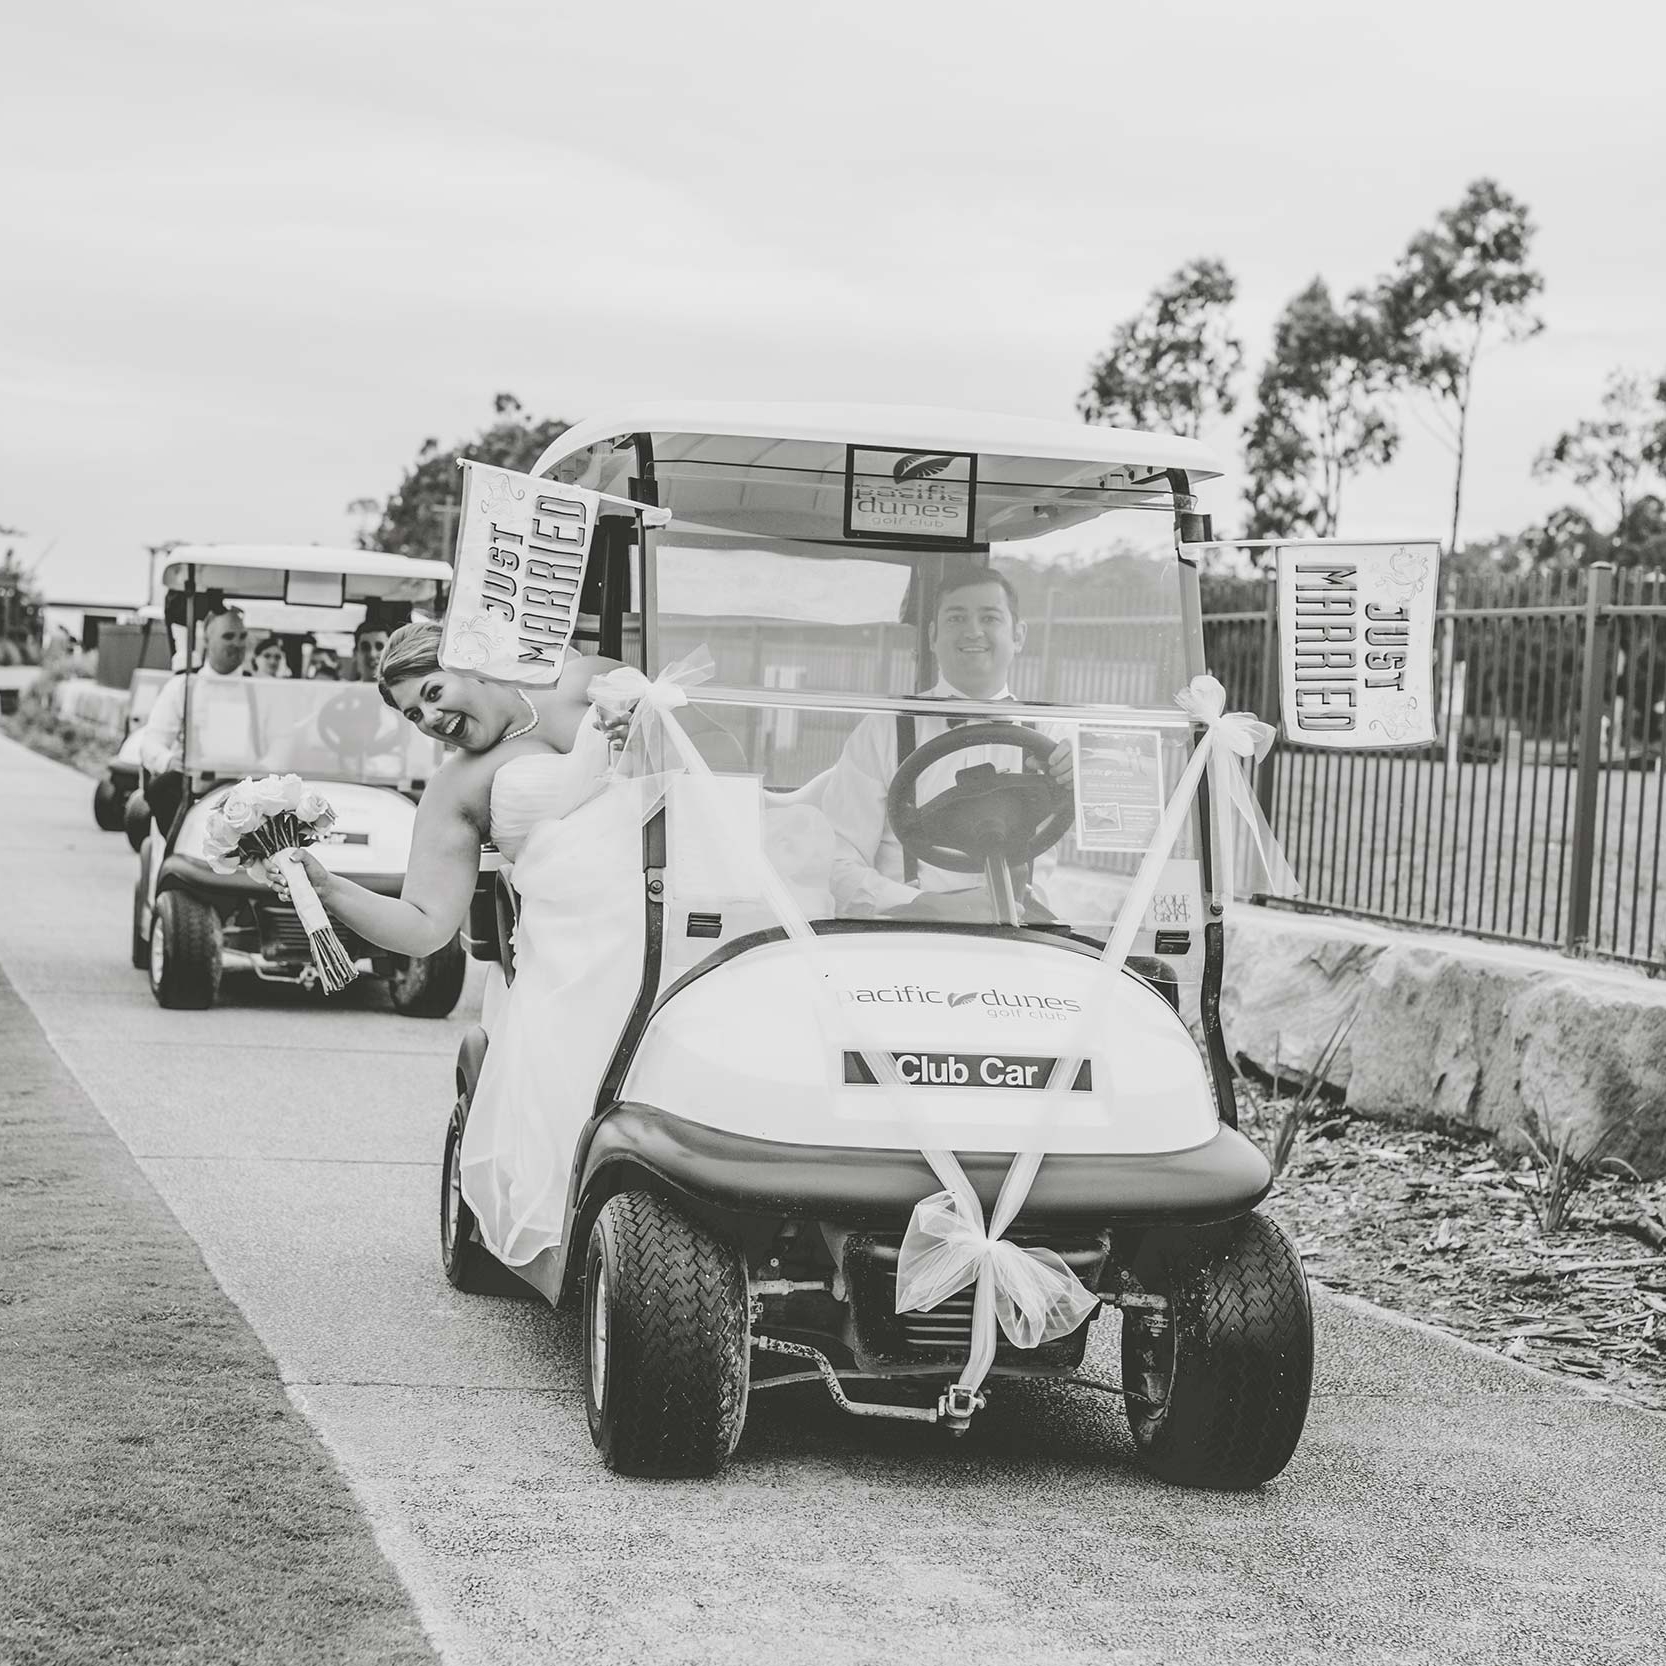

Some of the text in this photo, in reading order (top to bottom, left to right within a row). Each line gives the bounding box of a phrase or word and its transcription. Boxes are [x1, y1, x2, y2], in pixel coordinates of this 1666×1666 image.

[854, 483, 963, 502] pacific
[857, 497, 959, 518] dunes
[872, 516, 945, 528] golf club
[480, 522, 523, 622] JUST
[517, 494, 587, 667] MARRIED
[1295, 563, 1357, 731] MARRIED
[1365, 602, 1410, 691] JUST
[981, 989, 1082, 1012] dunes
[987, 1008, 1068, 1021] golf club
[896, 1054, 1039, 1087] Club Car
